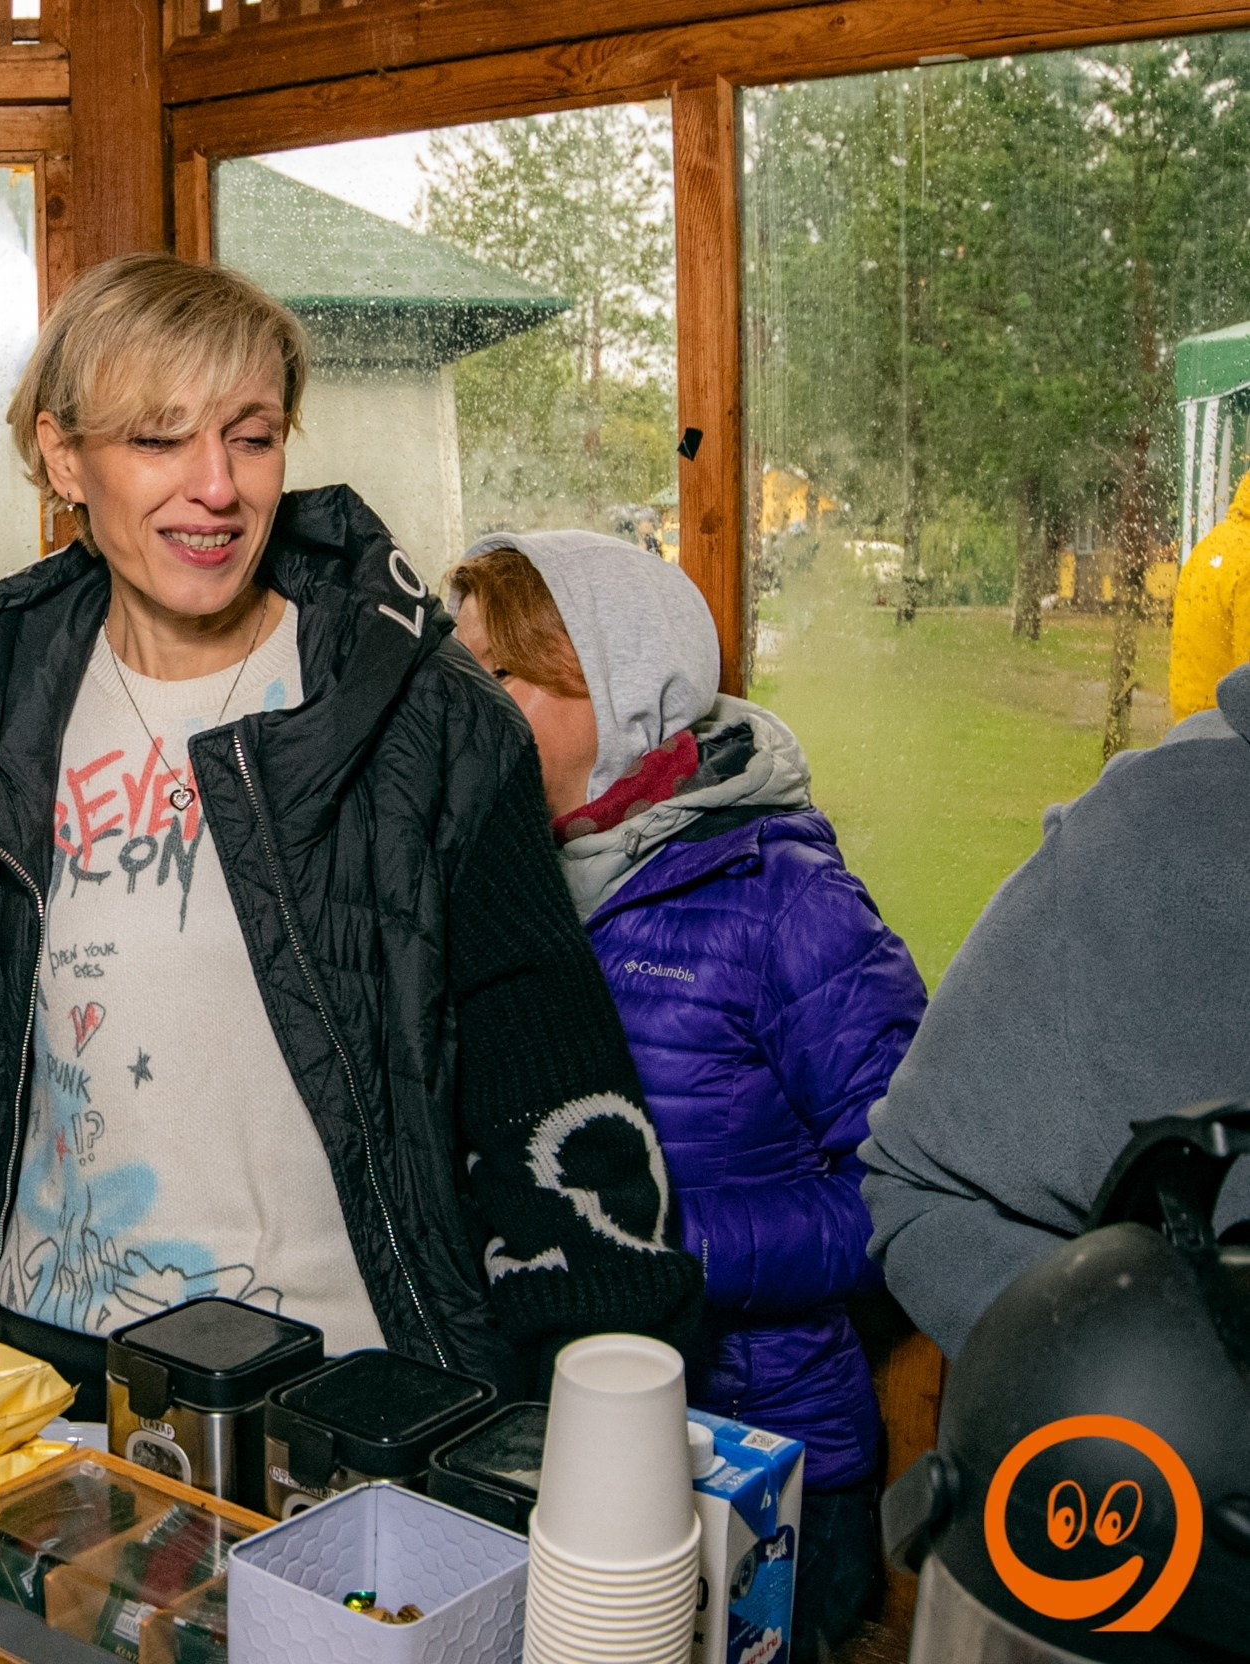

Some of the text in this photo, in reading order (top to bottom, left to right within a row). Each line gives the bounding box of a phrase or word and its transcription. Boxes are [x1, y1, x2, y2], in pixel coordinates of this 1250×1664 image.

[84, 942, 119, 958] YOUR
[73, 963, 104, 978] EYES
[638, 960, 695, 983] Columbia
[46, 1051, 91, 1103] PUNK
